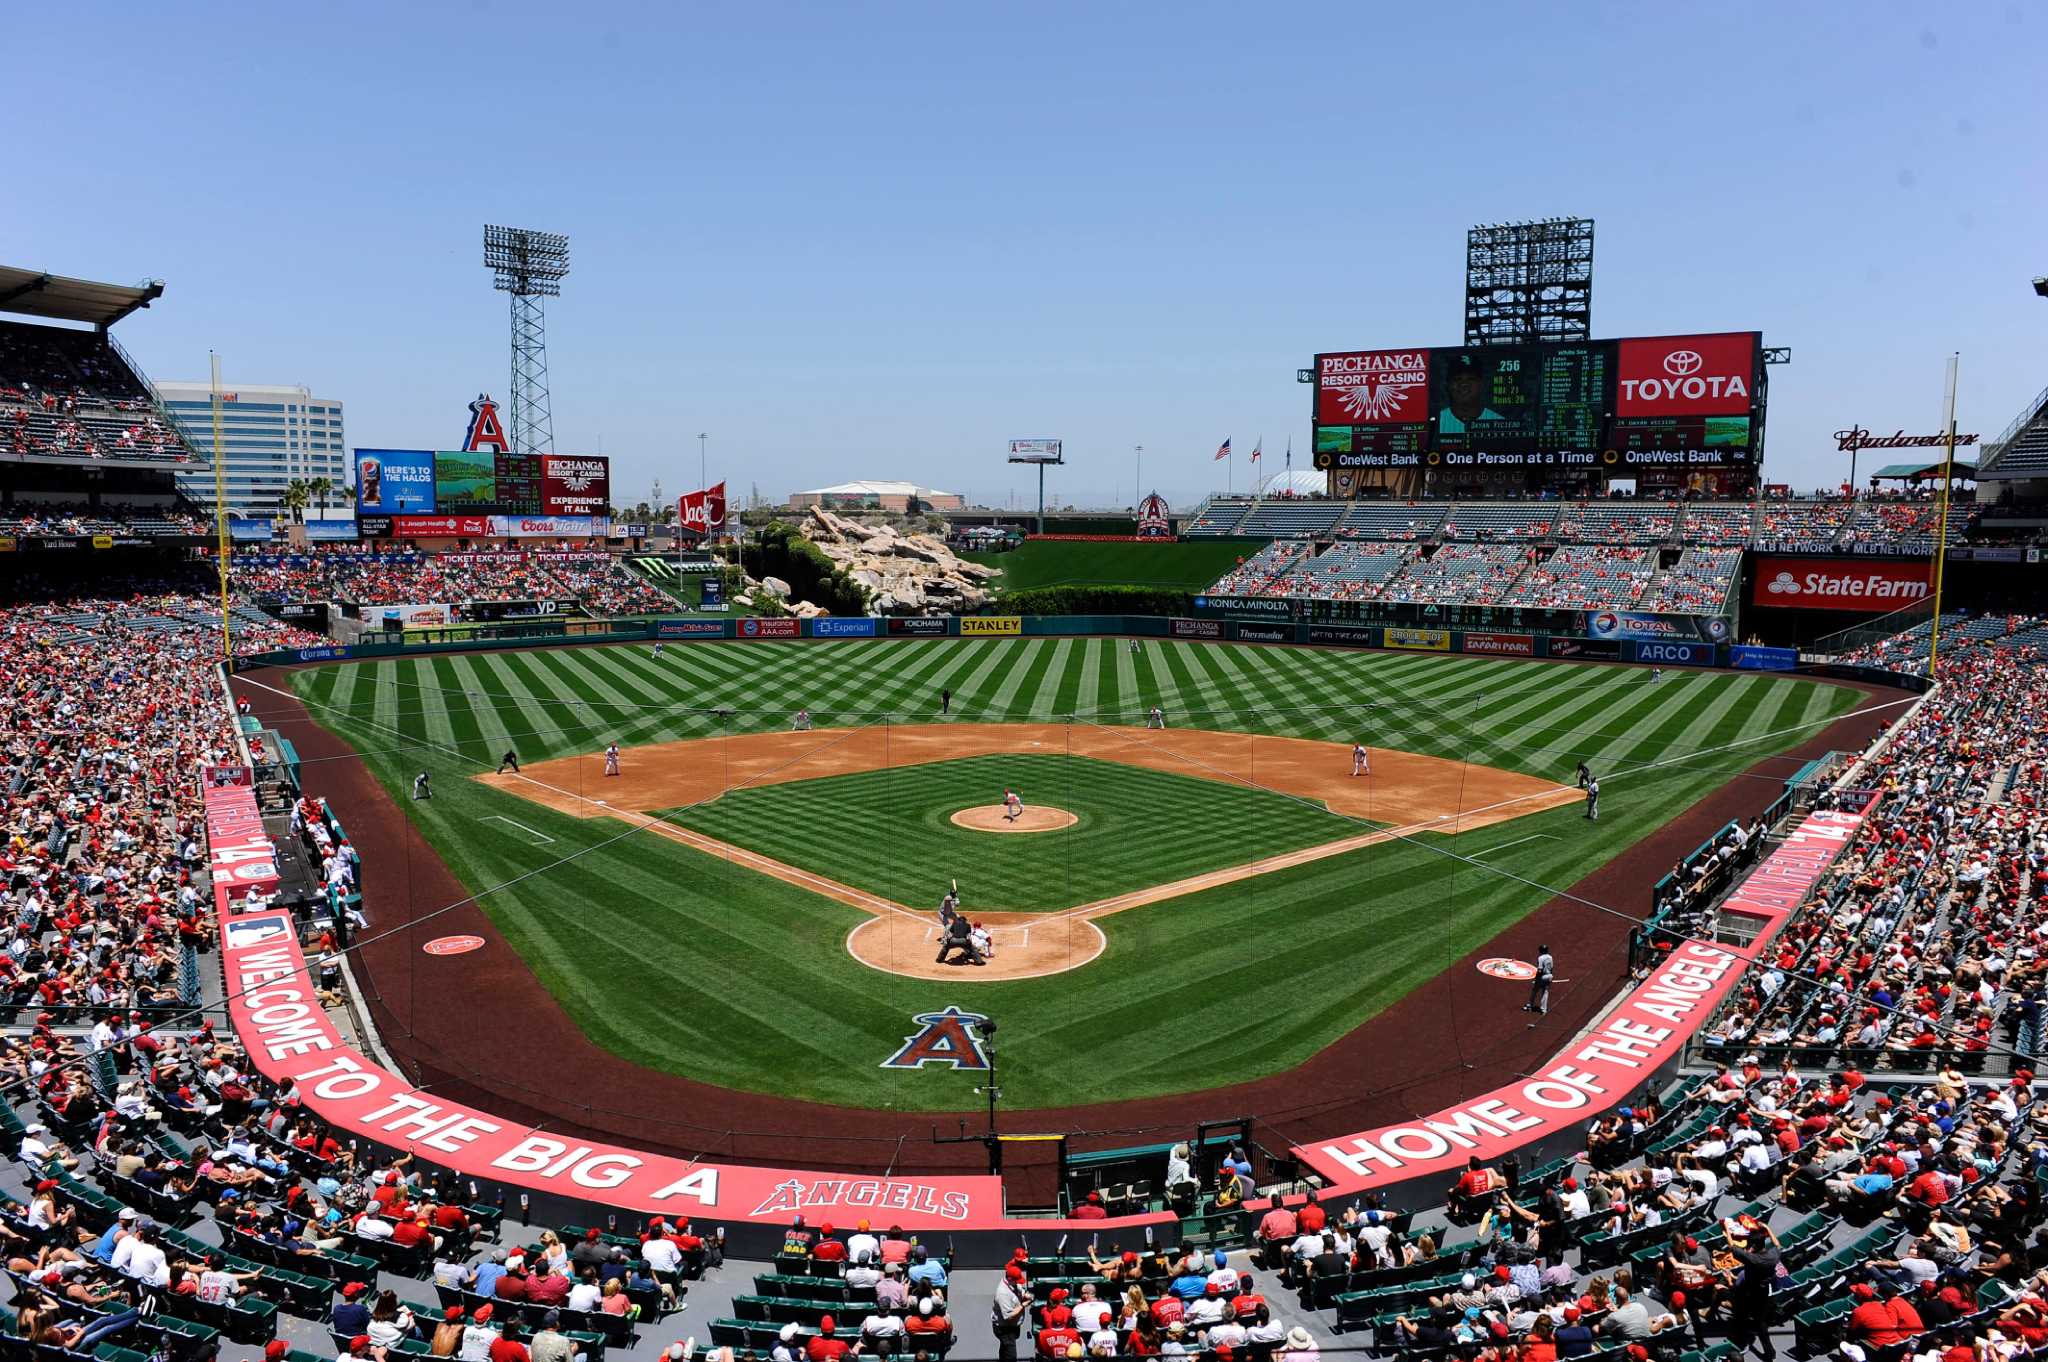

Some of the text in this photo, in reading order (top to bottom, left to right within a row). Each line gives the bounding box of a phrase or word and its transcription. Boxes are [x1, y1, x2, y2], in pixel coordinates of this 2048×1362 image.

[1322, 354, 1426, 372] PECHANGA
[1497, 360, 1520, 371] .256
[1322, 372, 1426, 386] RESORT CASINO
[1621, 376, 1748, 400] TOYOTA
[1834, 429, 1979, 451] Budweiser
[1340, 454, 1418, 466] OneWest Bank
[1446, 451, 1594, 464] One Person at a Time
[1626, 450, 1685, 463] OneWest
[1688, 450, 1722, 462] Bank
[384, 466, 431, 474] HERE'S TO
[548, 460, 604, 470] PECHANGA
[384, 474, 431, 482] THE HALOS
[681, 495, 724, 526] Jack
[520, 519, 554, 532] Coors
[42, 538, 76, 548] Yard House
[1754, 541, 1834, 554] MLB NETWORK
[1853, 543, 1880, 555] MLB
[1880, 544, 1937, 556] NETWORK
[443, 555, 475, 563] TICKET
[1803, 574, 1928, 598] State Farm
[536, 602, 556, 614] yp
[1208, 598, 1289, 611] KONICA MINOLTA
[833, 622, 868, 633] Experian
[904, 620, 943, 628] YOKOHAMA
[962, 620, 1018, 631] STANLEY
[1176, 620, 1220, 630] PECHANGA
[1623, 619, 1677, 632] TOTAL
[761, 628, 794, 636] AAA.com
[1240, 629, 1284, 640] Thermador
[1311, 630, 1333, 638] NITTO
[1467, 640, 1529, 652] SAFARI PARK
[1640, 646, 1691, 660] ARCO
[1634, 944, 1739, 1024] ANGELS
[236, 946, 334, 1061] WELCOME
[879, 1006, 995, 1070] A
[1580, 1018, 1675, 1069] THE
[295, 1056, 382, 1100] TO
[1523, 1065, 1606, 1110] OF
[360, 1092, 502, 1153] THE
[1321, 1099, 1545, 1177] HOME
[491, 1135, 644, 1190] BIG
[650, 1168, 720, 1208] A
[748, 1178, 969, 1220] ANGELS
